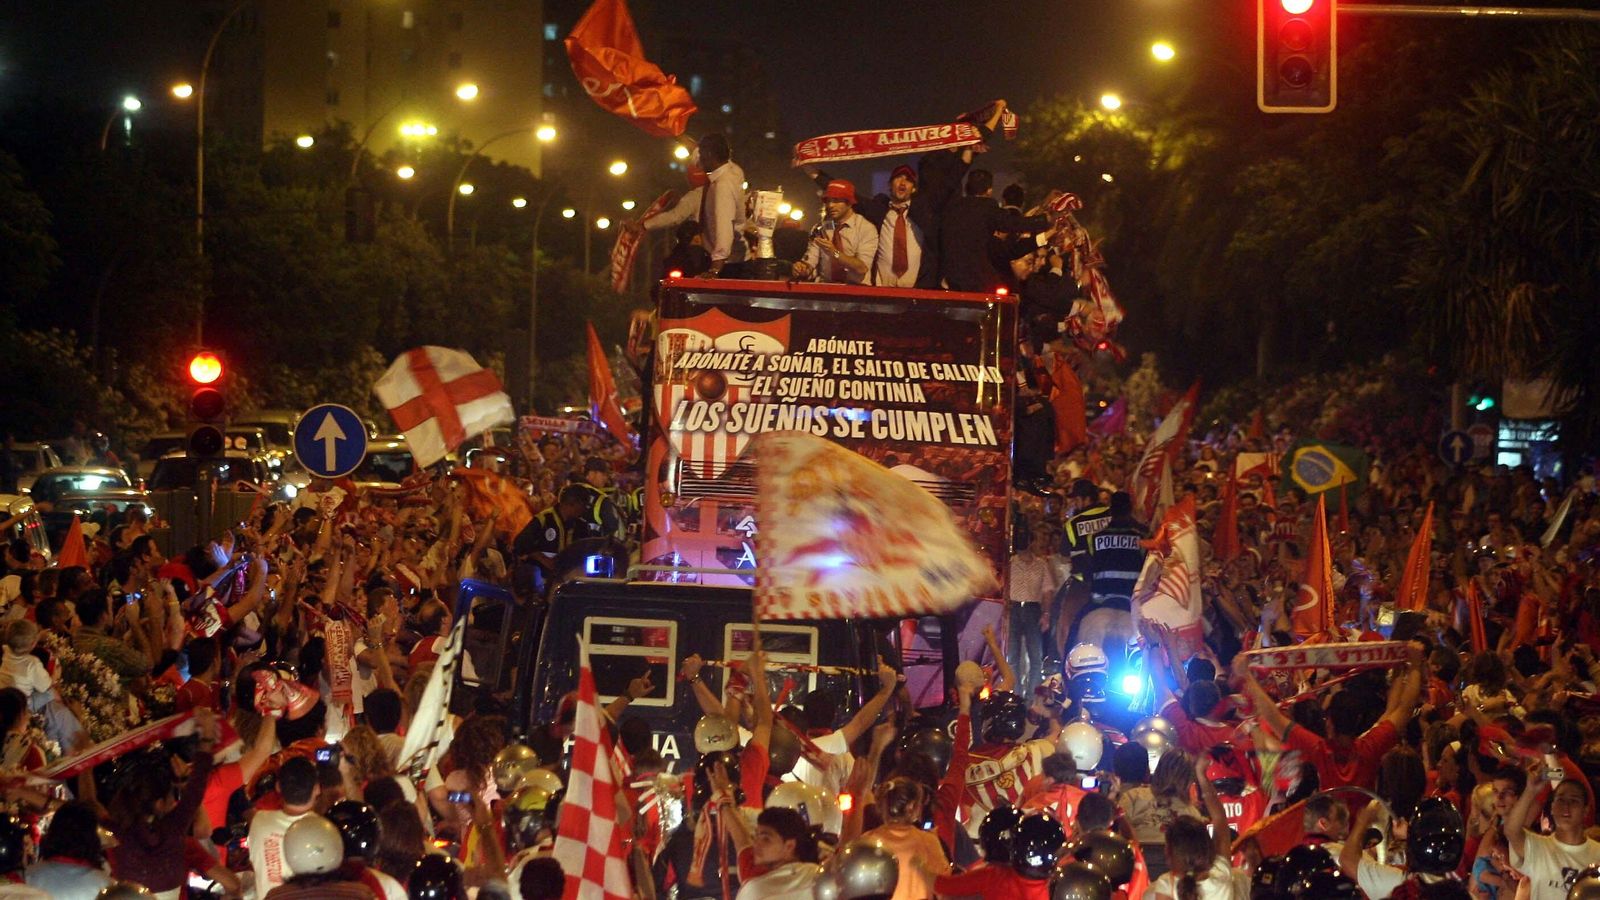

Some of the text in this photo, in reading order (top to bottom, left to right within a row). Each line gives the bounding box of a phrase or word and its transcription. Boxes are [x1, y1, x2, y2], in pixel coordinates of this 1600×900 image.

[806, 335, 875, 356] ABÓNATE
[673, 348, 1004, 384] ABÓNATE A SOÑAR, EL SALTO DE CALIDAD
[751, 376, 772, 396] EL
[777, 373, 835, 399] SUEÑO
[669, 396, 998, 446] LOS SUEÑOS SE CUMPLEN
[1096, 535, 1139, 549] POLICIA
